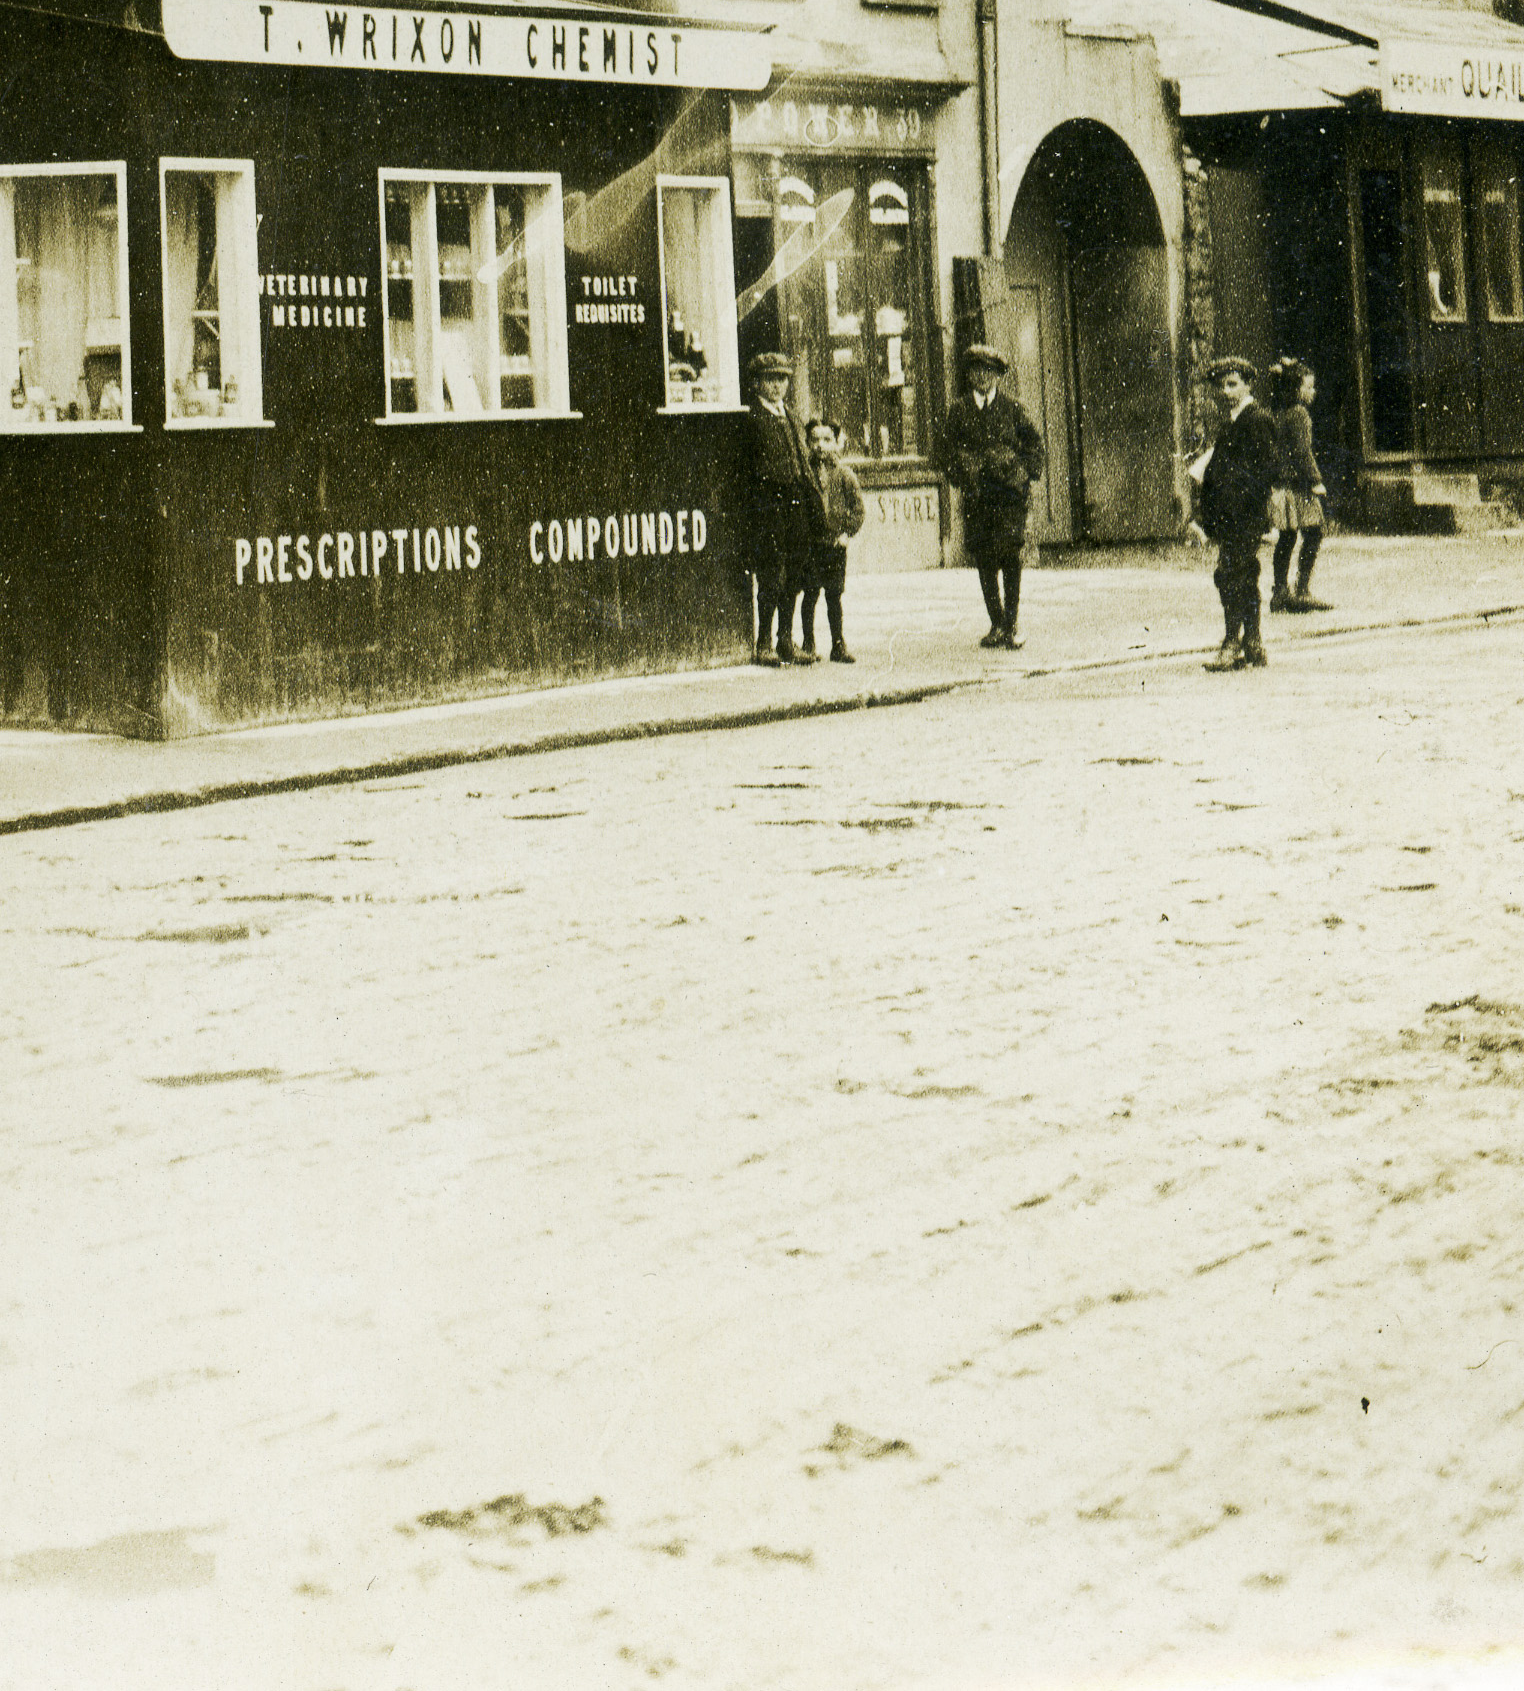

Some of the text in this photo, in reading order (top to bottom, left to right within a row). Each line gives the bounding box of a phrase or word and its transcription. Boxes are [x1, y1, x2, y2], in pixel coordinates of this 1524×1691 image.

[258, 5, 682, 76] T. WRIXON CHEMIST
[259, 274, 368, 298] VETERINARY
[581, 275, 638, 296] TOILET
[273, 304, 366, 328] MEDICINE
[575, 303, 646, 324] REQUISITES
[235, 509, 707, 586] PRESCRIPTIONS COMPOUNDED
